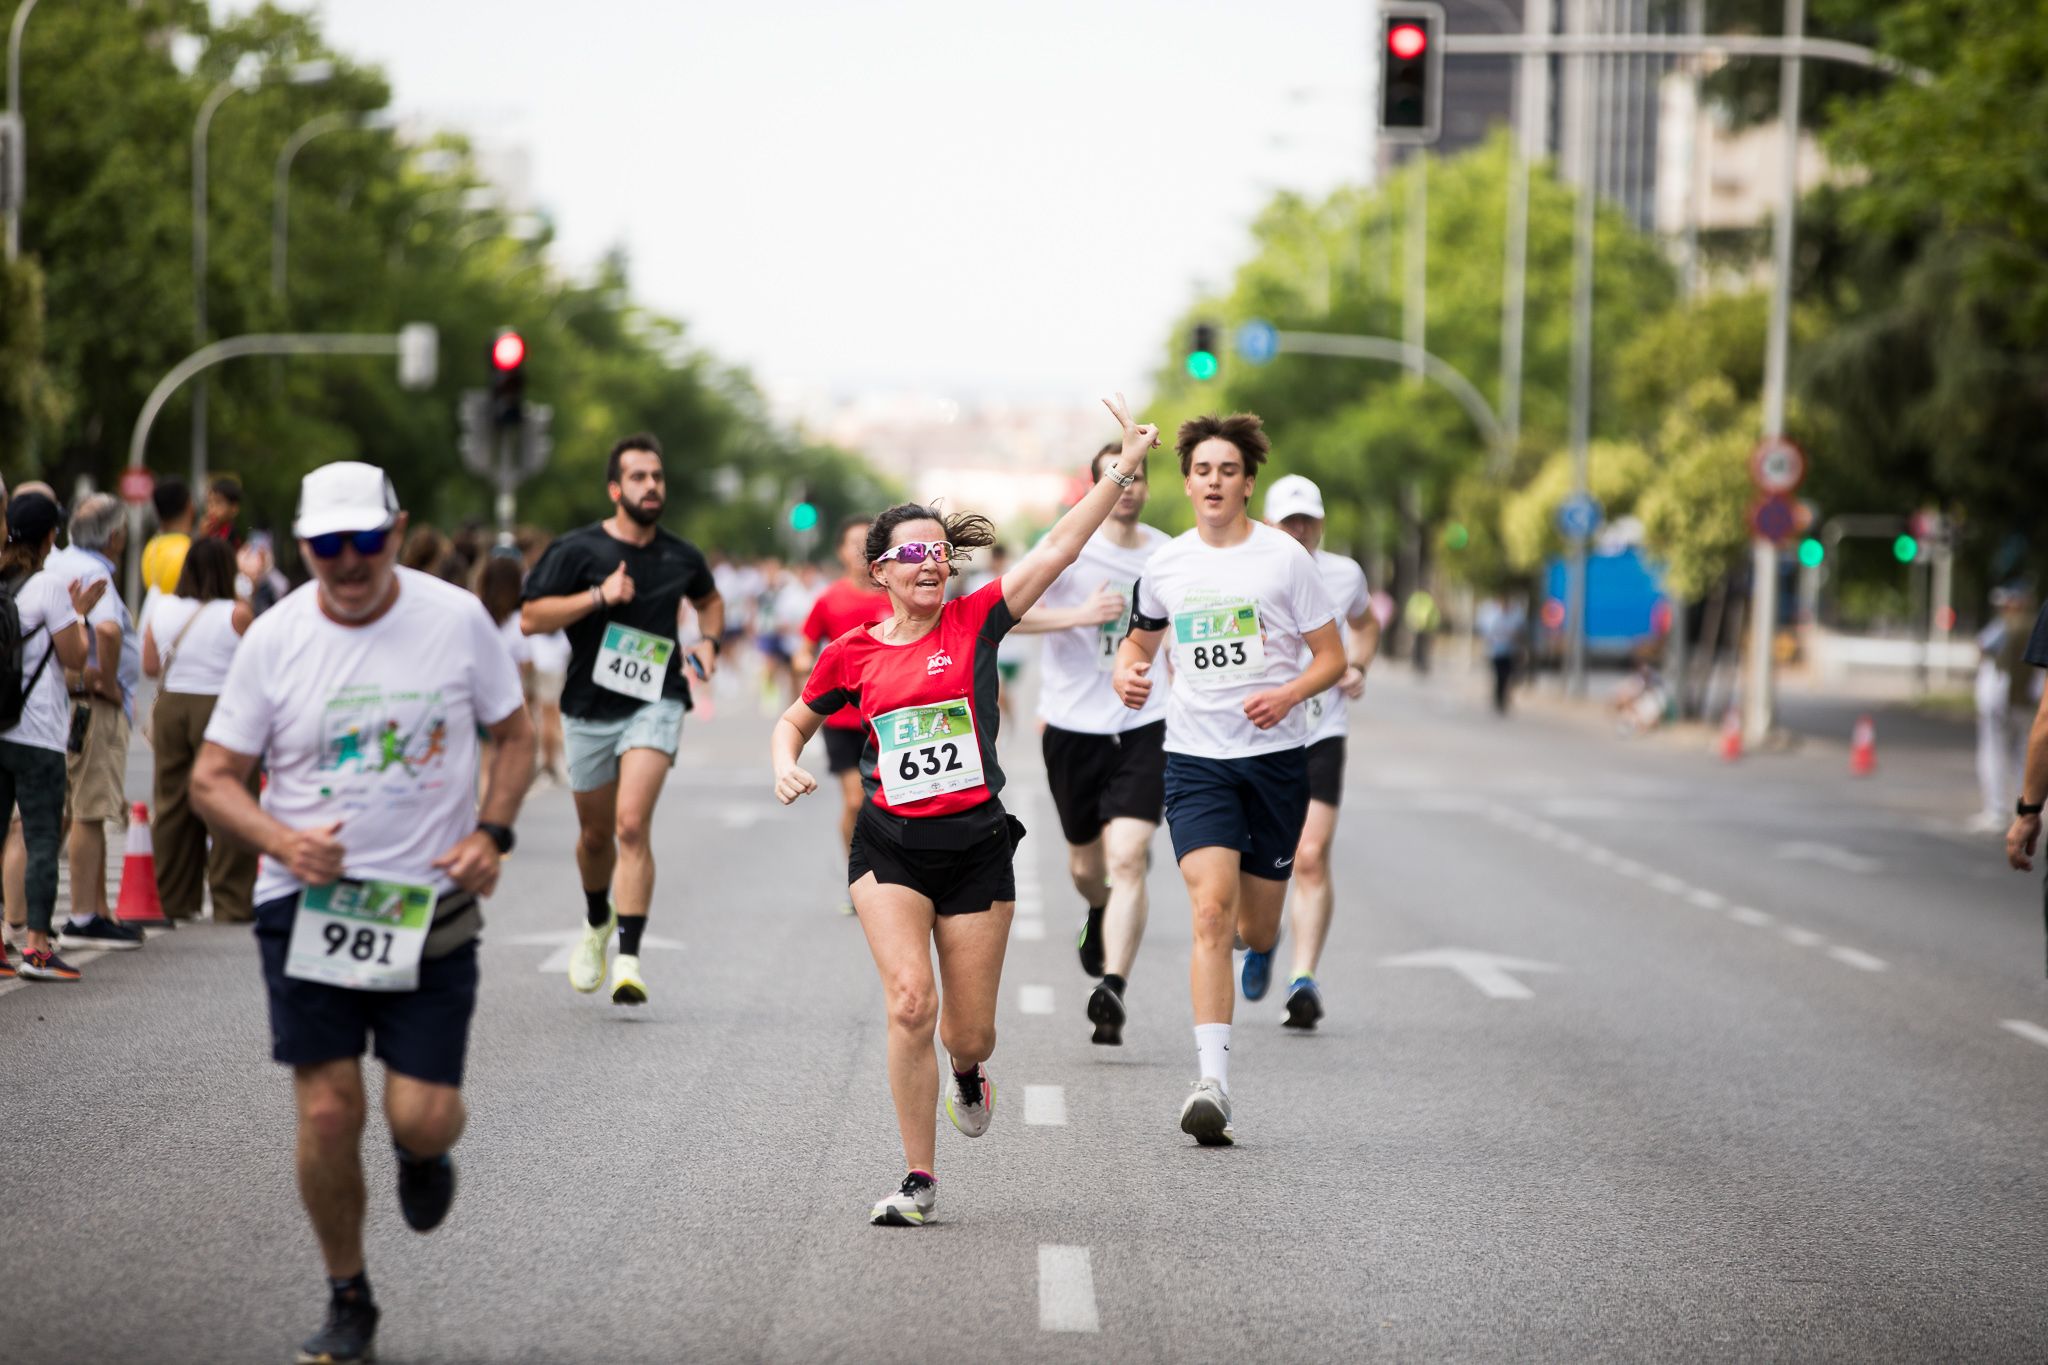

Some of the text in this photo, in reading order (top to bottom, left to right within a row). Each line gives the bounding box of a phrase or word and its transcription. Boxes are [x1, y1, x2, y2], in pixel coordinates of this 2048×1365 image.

[1191, 612, 1240, 639] ELA
[609, 656, 652, 683] 406
[927, 655, 953, 670] AON
[1194, 641, 1247, 670] 883
[894, 712, 951, 746] ELA
[899, 743, 963, 781] 632
[323, 921, 394, 965] 981
